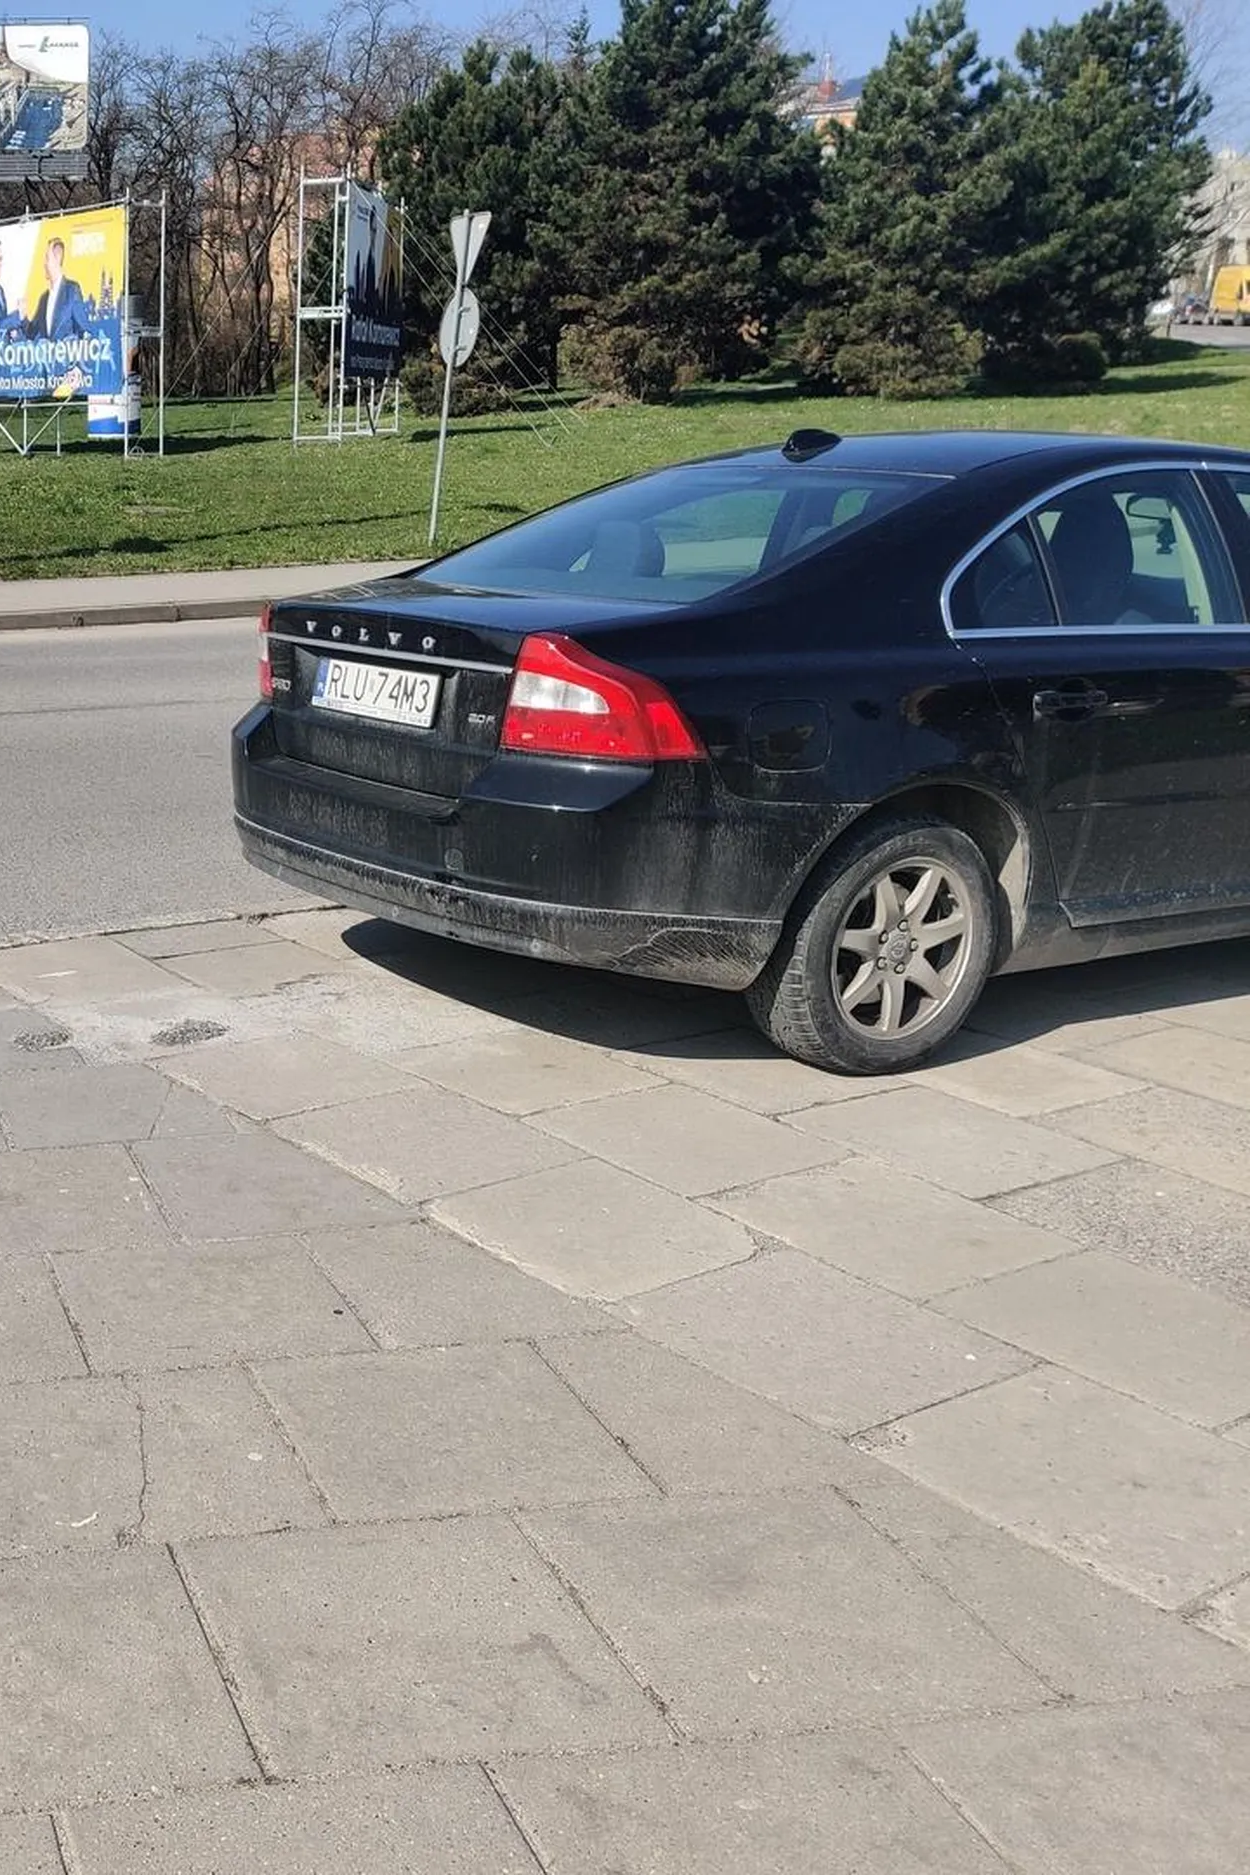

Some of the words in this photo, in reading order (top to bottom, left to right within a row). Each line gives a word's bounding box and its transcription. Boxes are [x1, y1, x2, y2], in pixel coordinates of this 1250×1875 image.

[12, 376, 46, 391] Miasta
[47, 374, 93, 390] Krawa
[305, 619, 437, 650] VOLVO
[327, 663, 370, 702] RLU
[372, 671, 431, 713] 74M3
